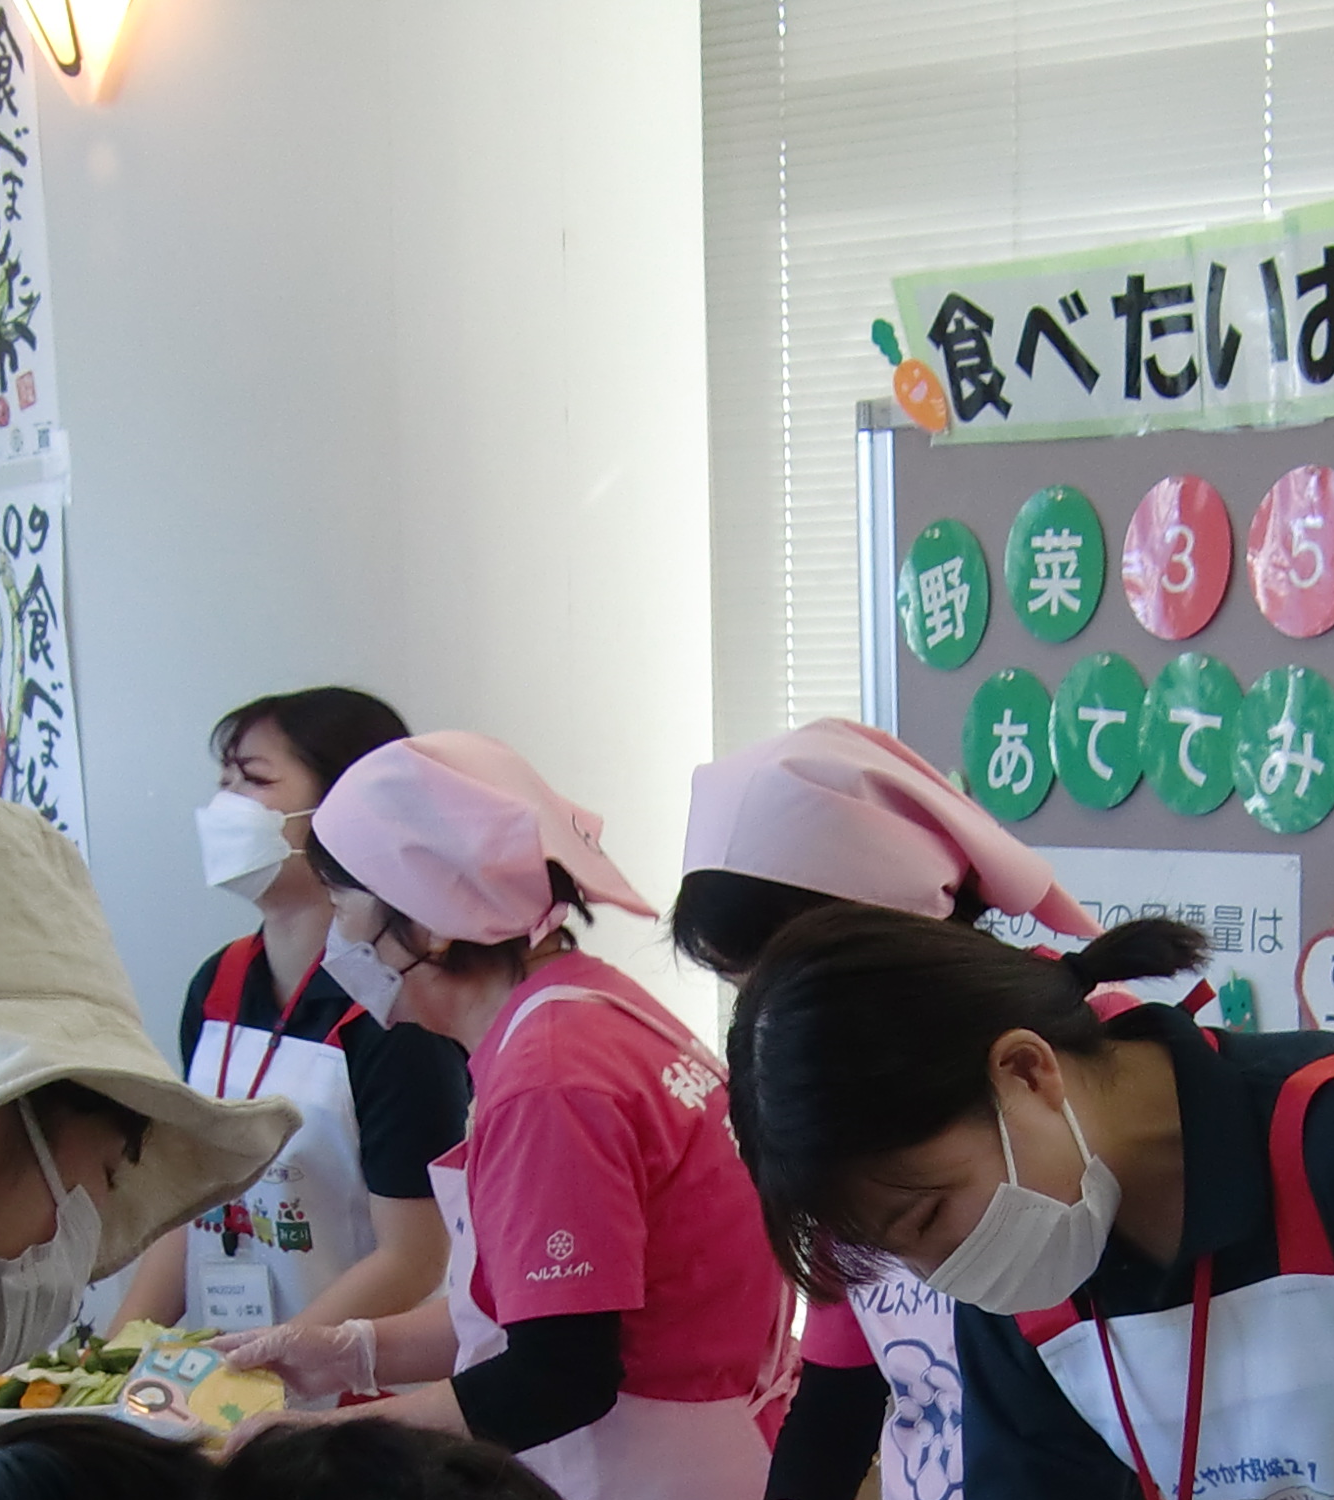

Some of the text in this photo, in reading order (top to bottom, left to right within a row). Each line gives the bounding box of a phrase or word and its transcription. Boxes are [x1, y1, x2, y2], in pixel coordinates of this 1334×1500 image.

[526, 1261, 594, 1281] ヘルスメイト
